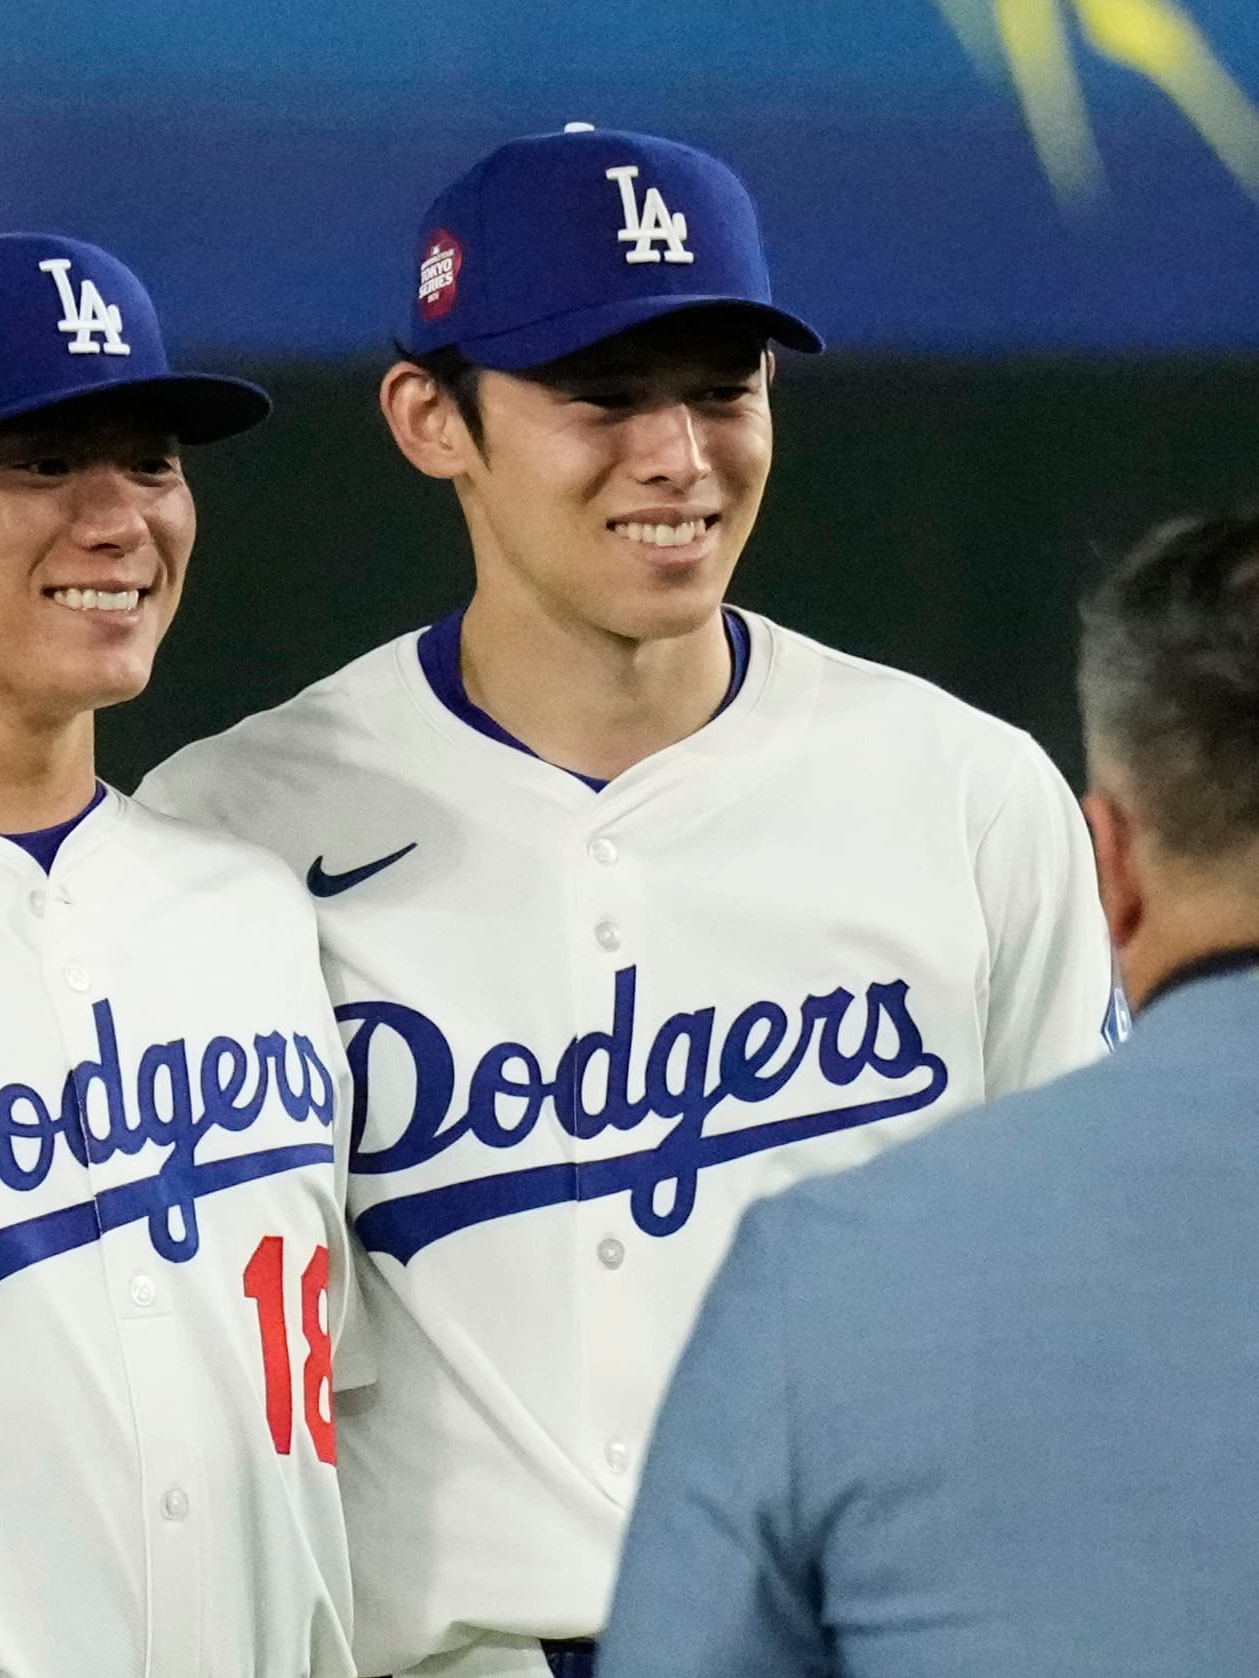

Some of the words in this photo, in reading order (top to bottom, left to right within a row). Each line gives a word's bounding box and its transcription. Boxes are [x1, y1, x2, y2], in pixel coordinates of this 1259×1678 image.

[606, 165, 694, 264] LA
[38, 258, 131, 356] LA
[419, 271, 454, 299] SERIES
[421, 258, 453, 285] TOKYO
[333, 963, 949, 1238] Dodgers
[243, 1236, 338, 1467] 18
